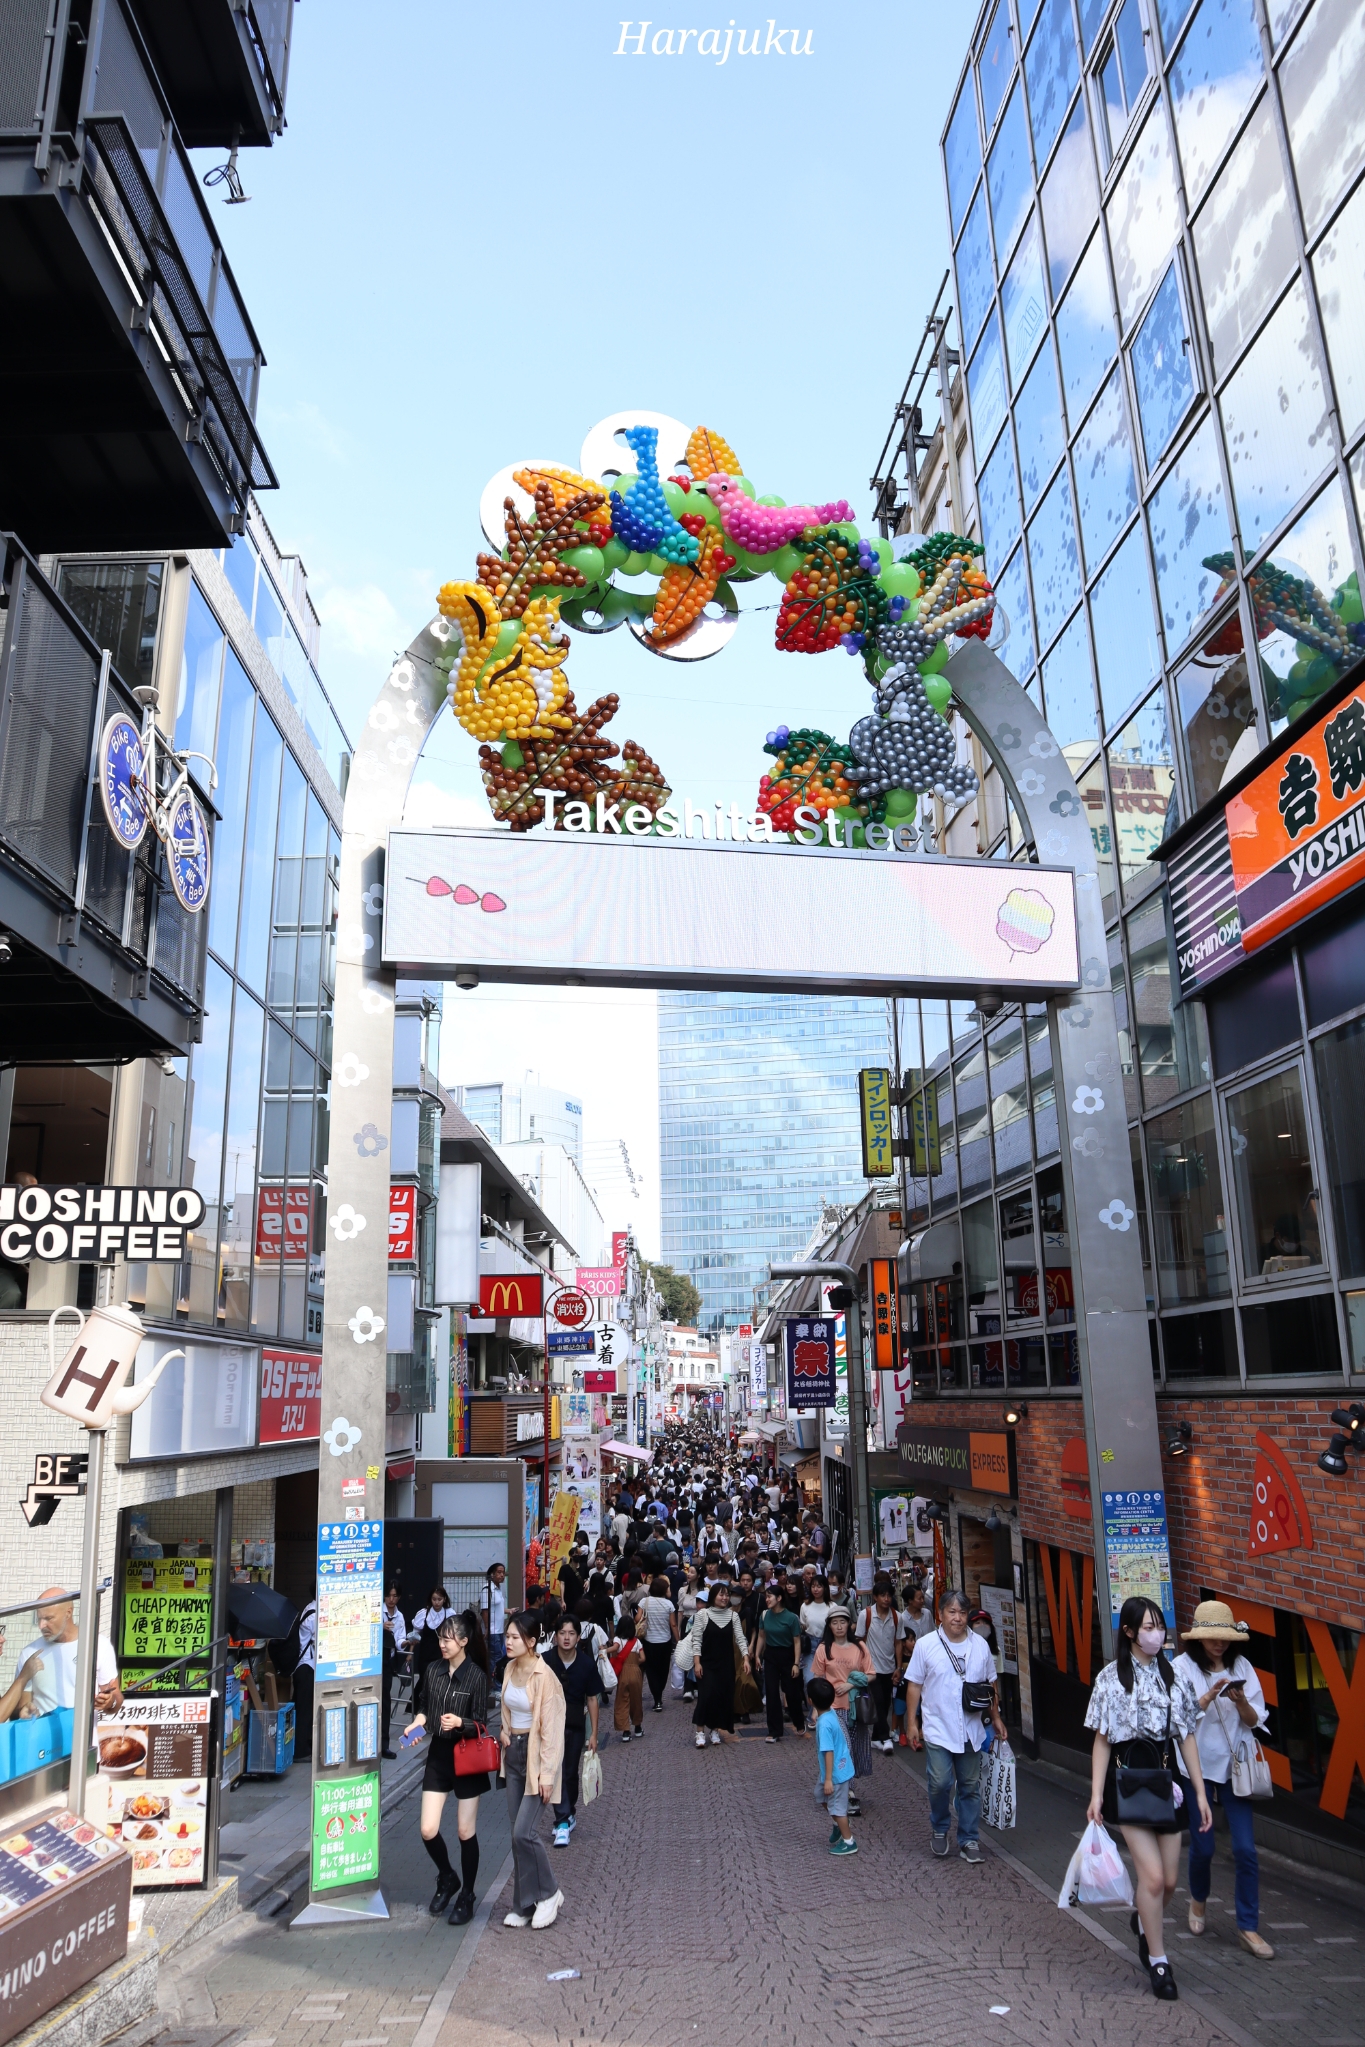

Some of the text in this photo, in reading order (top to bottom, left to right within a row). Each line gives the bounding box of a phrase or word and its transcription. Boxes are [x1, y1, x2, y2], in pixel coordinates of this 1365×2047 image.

[533, 788, 939, 854] Takeshita Street
[1179, 916, 1241, 975] YOSHINOYA
[868, 1071, 888, 1162] コインロッカー
[870, 1164, 891, 1173] 3F
[0, 1223, 183, 1259] COFFEE
[557, 1303, 585, 1316] 消火栓
[877, 1292, 889, 1335] 吉野家
[597, 1324, 615, 1365] 古着
[795, 1323, 828, 1338] 奉納
[754, 1347, 762, 1390] コインロッカー
[793, 1340, 830, 1378] 祭
[54, 1346, 120, 1412] H
[281, 1405, 307, 1433] クスリ
[35, 1456, 72, 1485] BF
[900, 1442, 1006, 1473] WOLFGANG PUCK EXPRESS
[1107, 1542, 1167, 1550] 竹下通り公式マップ
[127, 1560, 154, 1568] JAPAN
[130, 1597, 212, 1614] CHEAP PHARMACY
[132, 1616, 207, 1634] 便宜的药店
[185, 1703, 207, 1715] BF
[321, 1796, 373, 1816] 歩行者用道路
[319, 1848, 373, 1870] 押して歩きましょう
[320, 1840, 345, 1856] 自転車は
[51, 1903, 117, 1966] COFFEE
